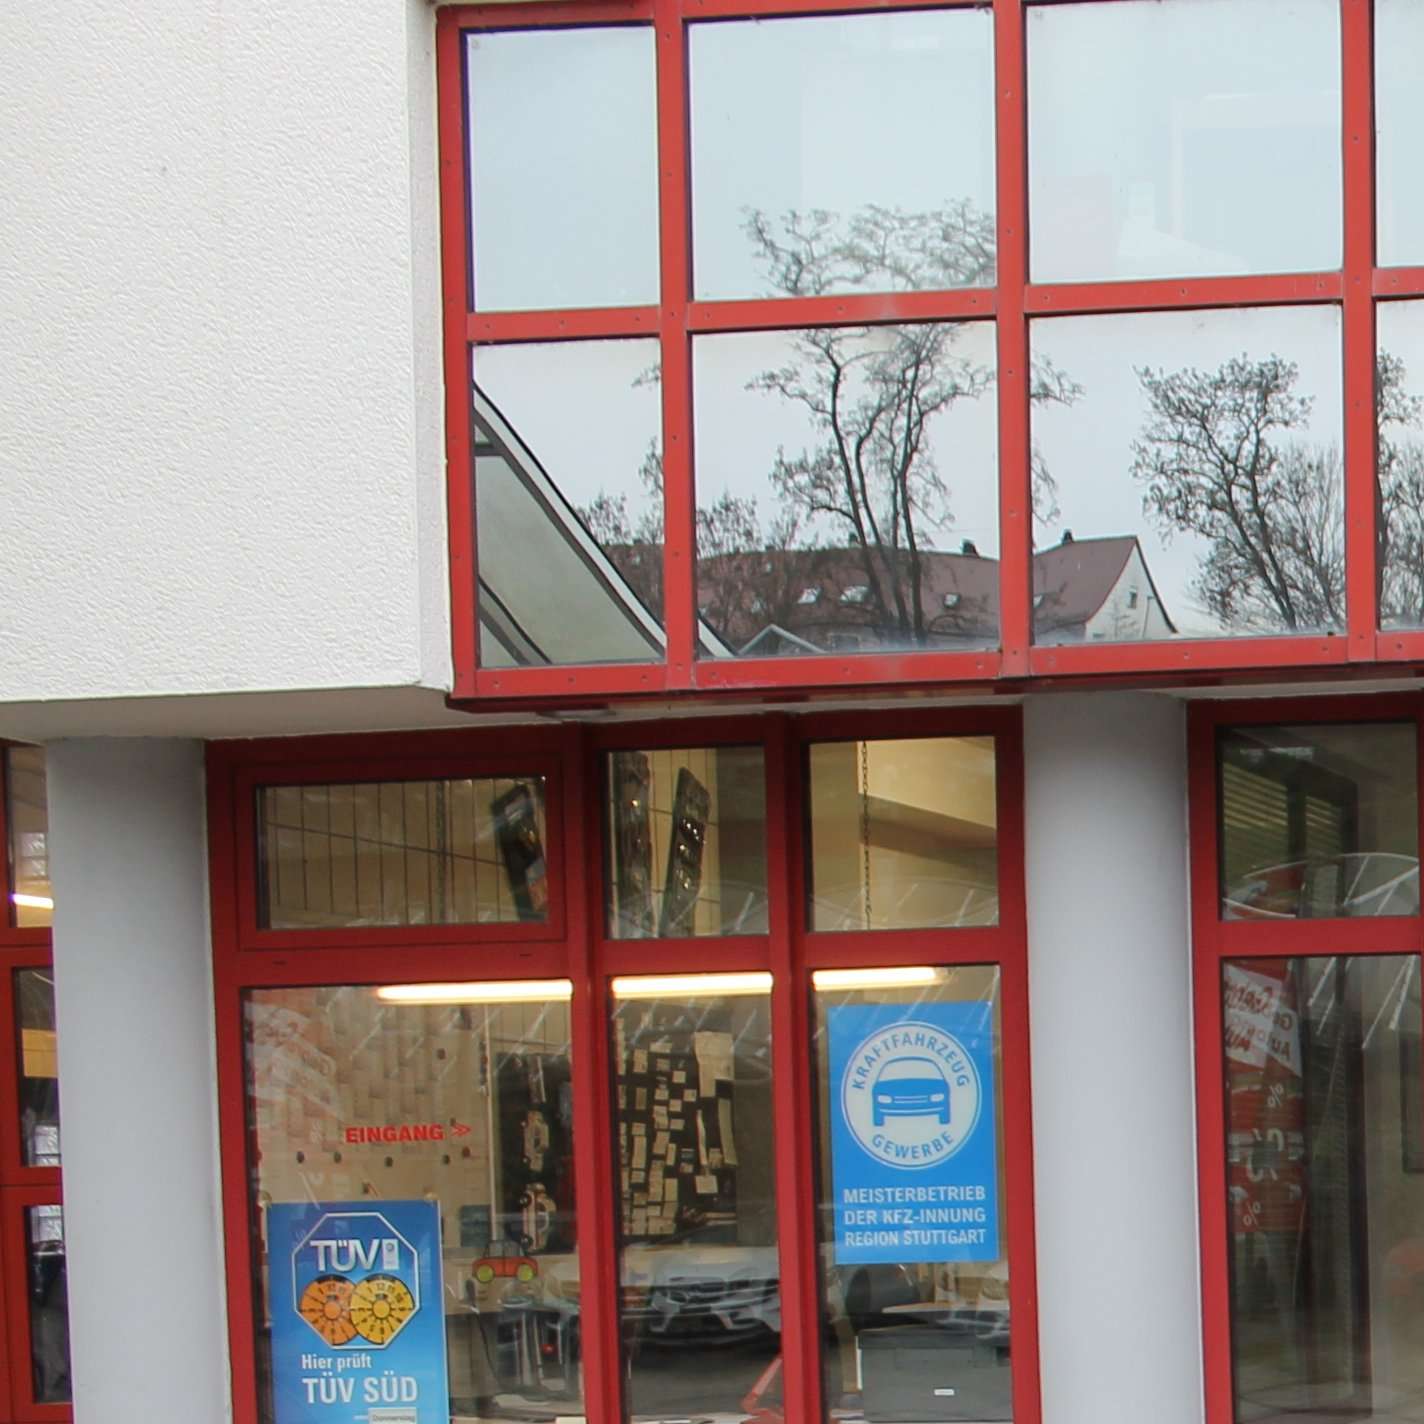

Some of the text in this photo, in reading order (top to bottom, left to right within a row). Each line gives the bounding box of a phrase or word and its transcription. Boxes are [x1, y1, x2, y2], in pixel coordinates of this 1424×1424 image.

[852, 1031, 970, 1091] KRAFTFAHRZEUG
[345, 1122, 444, 1143] EINGANG
[872, 1131, 955, 1160] GEWERBE
[843, 1185, 986, 1204] MEISTERBETRIEB
[844, 1207, 986, 1225] DER KFZ-INNUNG
[845, 1228, 986, 1247] REGION STUTTGART
[310, 1237, 379, 1273] TÜV
[301, 1353, 372, 1373] Hier prüft
[302, 1370, 418, 1404] TÜV SÜD
